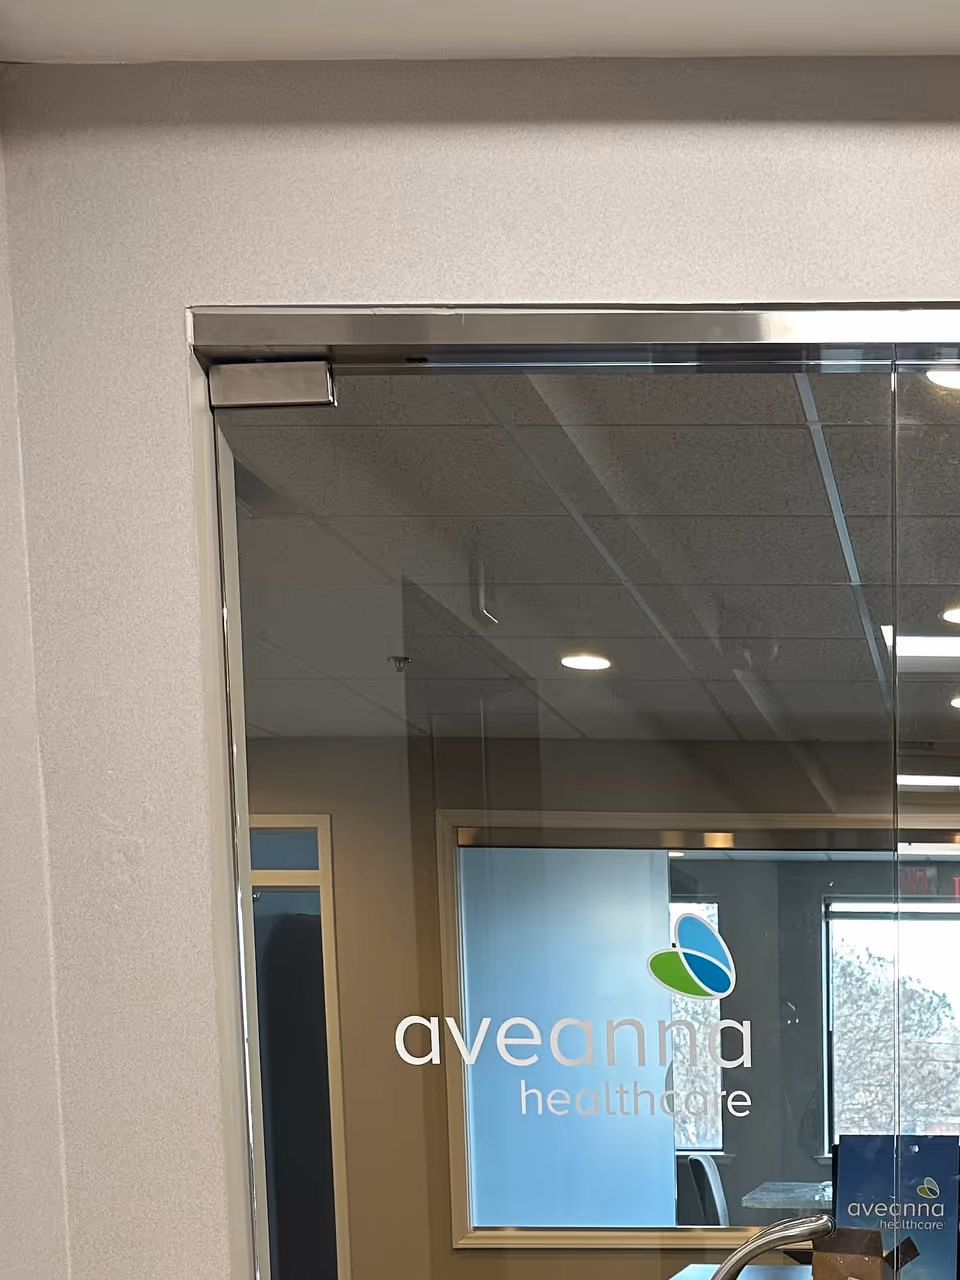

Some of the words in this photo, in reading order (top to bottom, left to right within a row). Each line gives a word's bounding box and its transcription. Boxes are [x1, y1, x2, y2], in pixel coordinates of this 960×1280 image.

[394, 1013, 752, 1068] aveanna
[520, 1080, 752, 1117] healthcare
[847, 1203, 945, 1217] aveanna
[879, 1219, 944, 1230] healthcare
